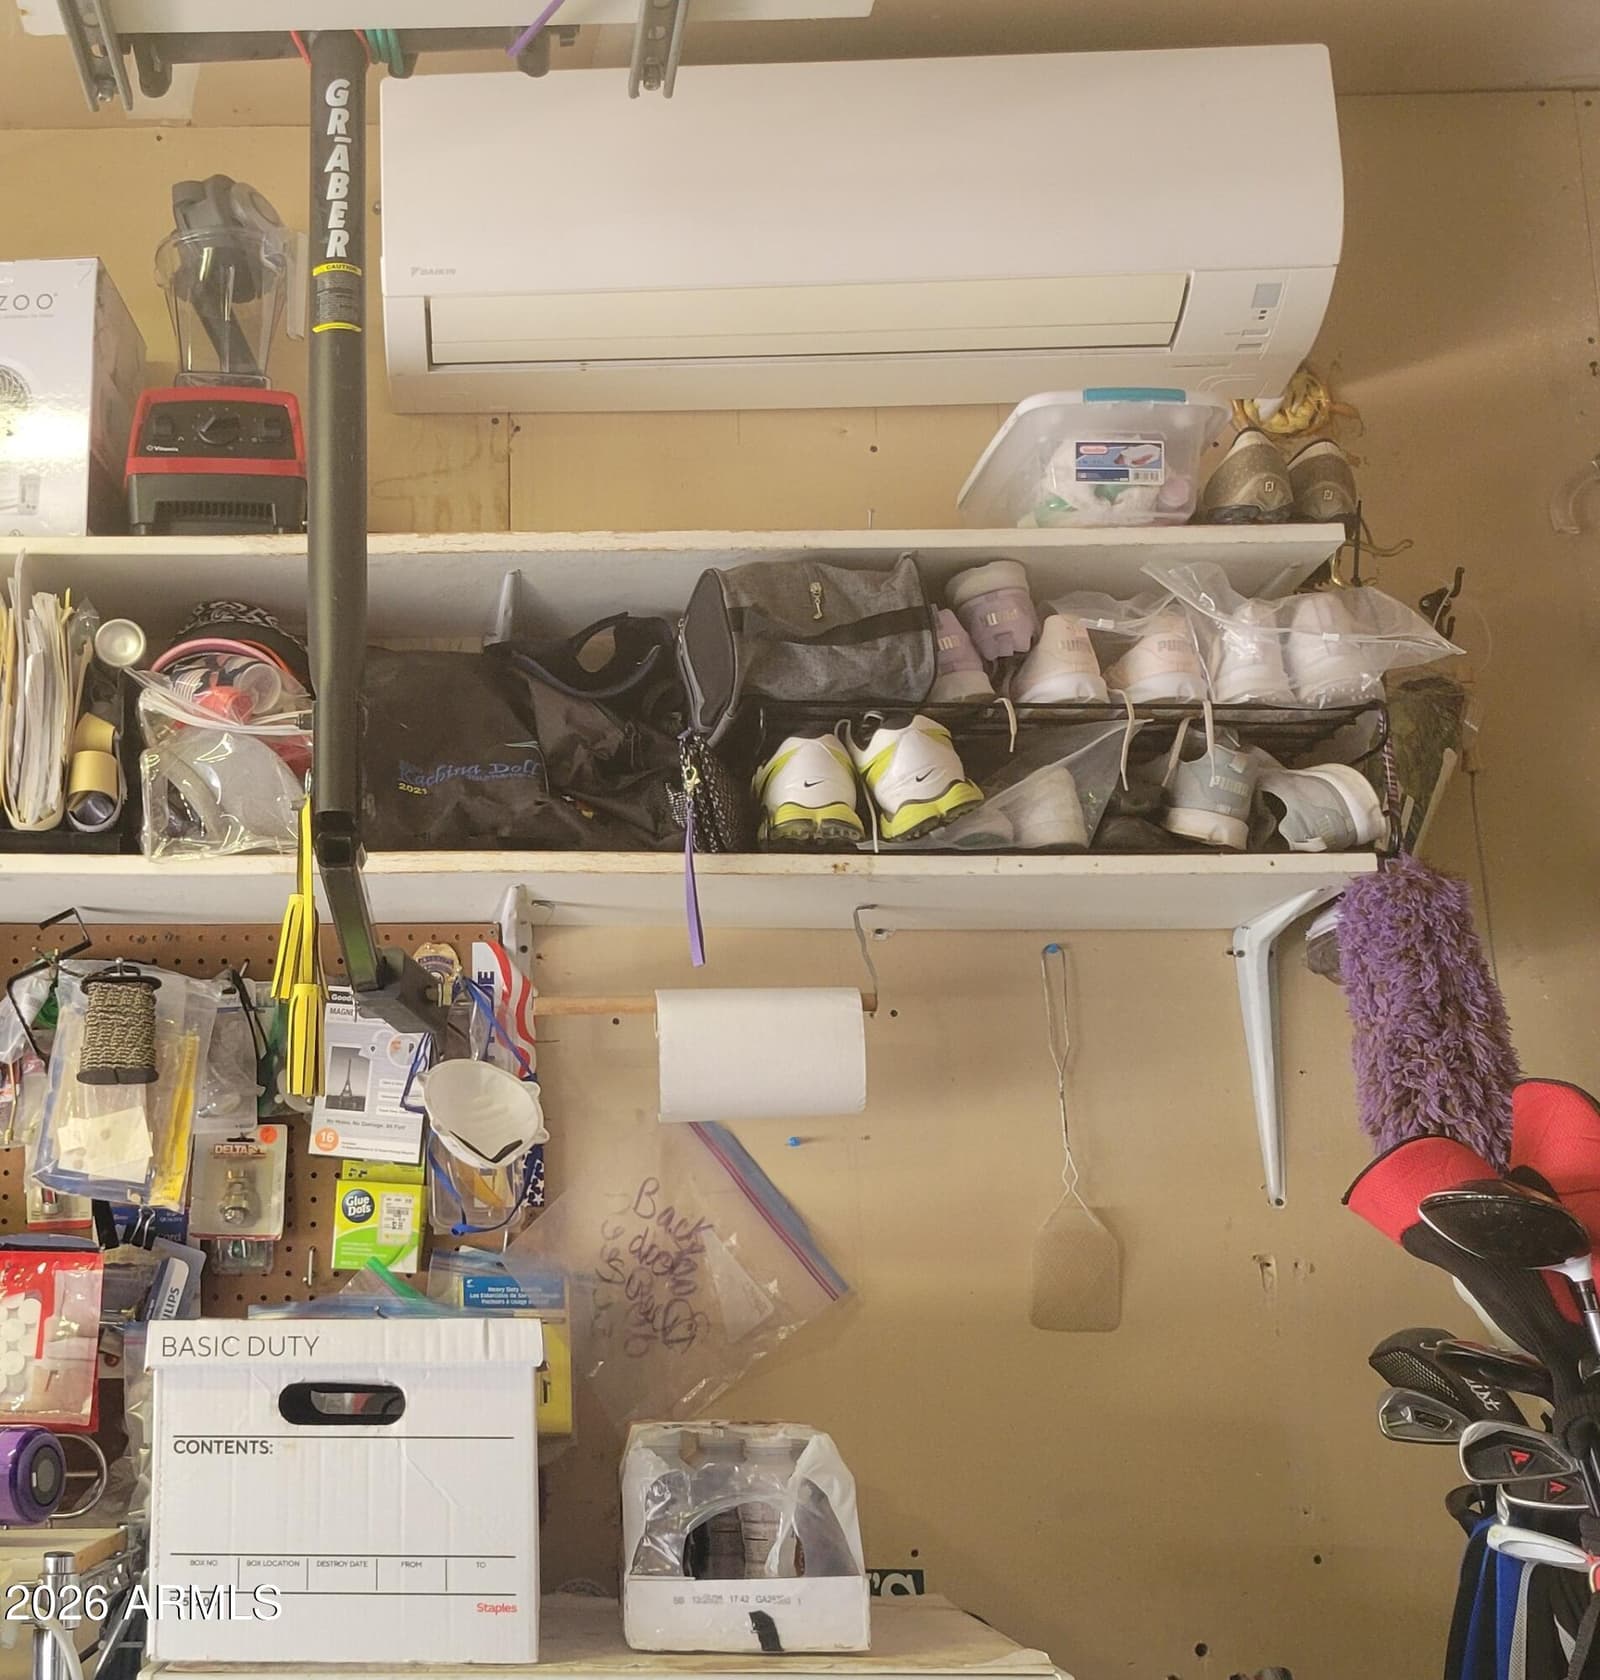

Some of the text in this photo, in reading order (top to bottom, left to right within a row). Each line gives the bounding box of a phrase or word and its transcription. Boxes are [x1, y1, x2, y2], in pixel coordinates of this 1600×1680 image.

[398, 782, 428, 795] 2021
[321, 1132, 335, 1143] 16
[215, 1144, 247, 1154] DELTA
[345, 1195, 370, 1207] Glue
[347, 1204, 372, 1217] Dots
[162, 1287, 180, 1320] ILIPS
[162, 1336, 319, 1357] BASIC DUTY
[173, 1439, 273, 1454] CONTENTS:
[190, 1559, 204, 1567] BOX
[316, 1560, 369, 1568] DESTROY DATE
[476, 1561, 487, 1569] TO
[477, 1602, 518, 1615] Staples
